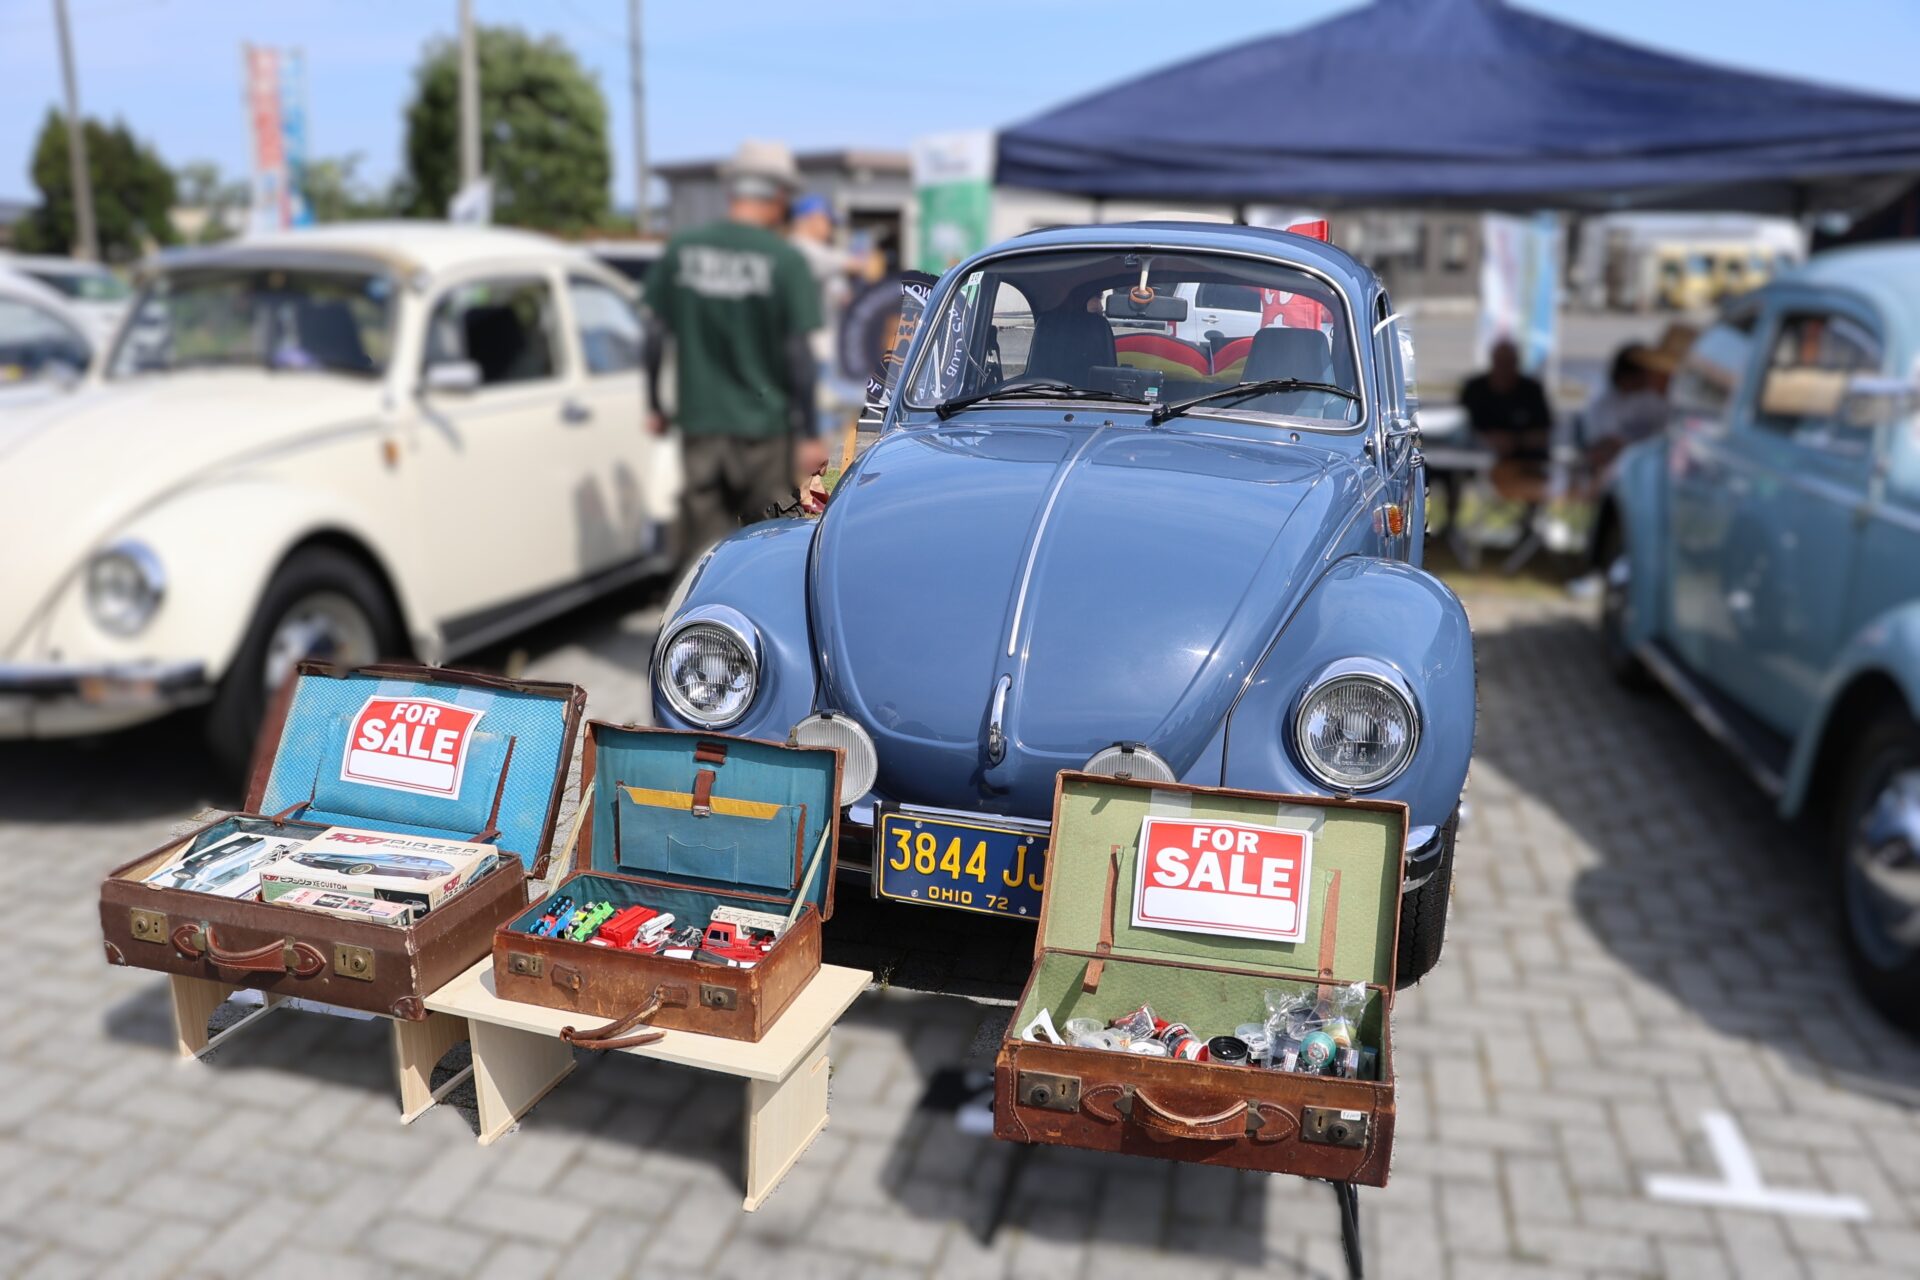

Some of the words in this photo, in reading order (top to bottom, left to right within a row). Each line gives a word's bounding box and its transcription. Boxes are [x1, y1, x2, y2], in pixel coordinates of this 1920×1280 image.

[946, 338, 963, 377] CLUB
[390, 703, 441, 726] FOR
[358, 718, 460, 763] SALE
[390, 839, 478, 854] PIAZZA
[1192, 827, 1260, 854] FOR
[889, 827, 987, 884] 3844
[320, 881, 348, 890] CUSTOM
[1152, 847, 1294, 898] SALE
[928, 886, 973, 904] OHIO
[985, 894, 1009, 910] 72
